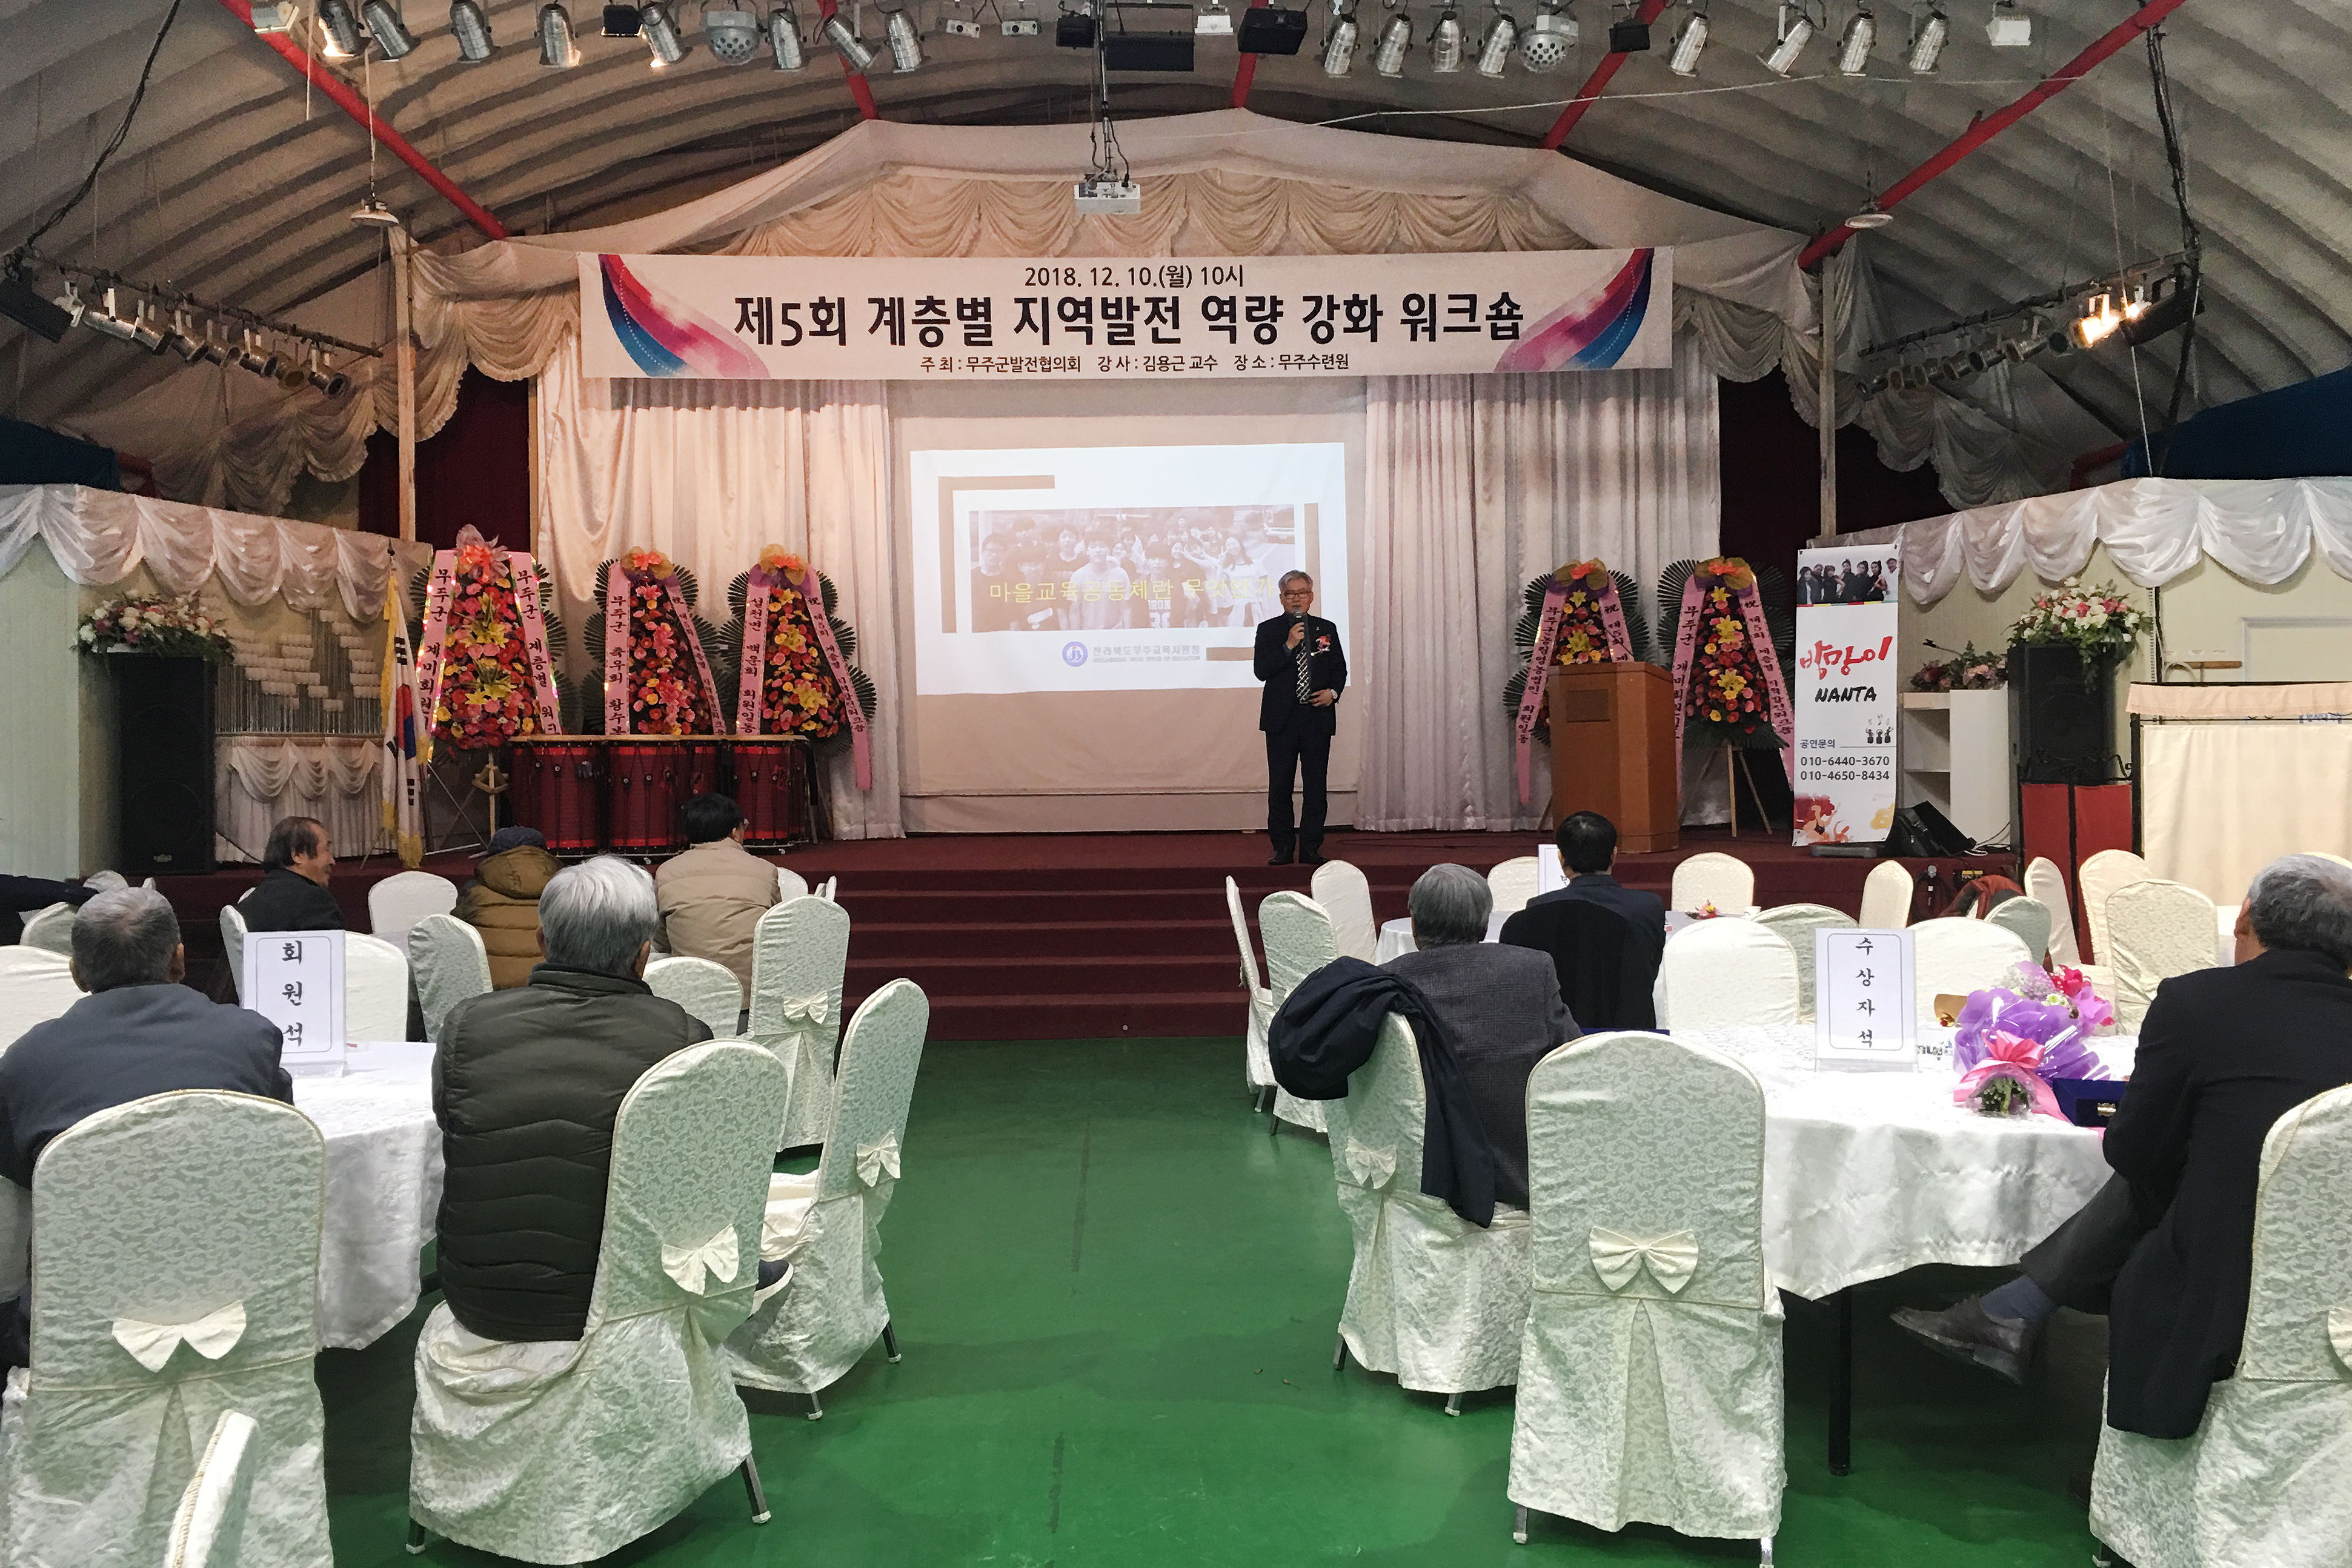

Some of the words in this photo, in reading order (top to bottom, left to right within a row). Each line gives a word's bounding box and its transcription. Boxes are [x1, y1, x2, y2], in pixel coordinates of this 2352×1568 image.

[1025, 267, 1081, 288] 2018.
[1090, 267, 1120, 287] 12.
[1128, 265, 1192, 289] 10.(월)
[1201, 264, 1243, 287] 10시
[734, 296, 846, 347] 제5회
[867, 295, 994, 348] 계층별
[1013, 295, 1181, 346] 지역발전
[1201, 294, 1284, 345] 역량
[1302, 293, 1384, 345] 강화
[1400, 291, 1524, 342] 워크숍
[966, 356, 1081, 373] 무주군발전협의회
[1143, 355, 1186, 372] 김용근
[1189, 354, 1218, 371] 교수
[1278, 353, 1349, 371] 무주수련원
[431, 568, 452, 622] 무주군
[989, 579, 1174, 603] 마을교육공동체란
[610, 596, 627, 633] 무주군
[1679, 605, 1699, 646] 무주군
[517, 570, 539, 620] 무주군
[528, 638, 547, 688] 계층별
[1815, 686, 1877, 703] NANTA
[740, 689, 756, 734] 회원일동
[1800, 739, 1835, 749] 공연문의
[1800, 756, 1890, 766] 010-6440-3670
[1800, 771, 1890, 780] 010-4650-8434
